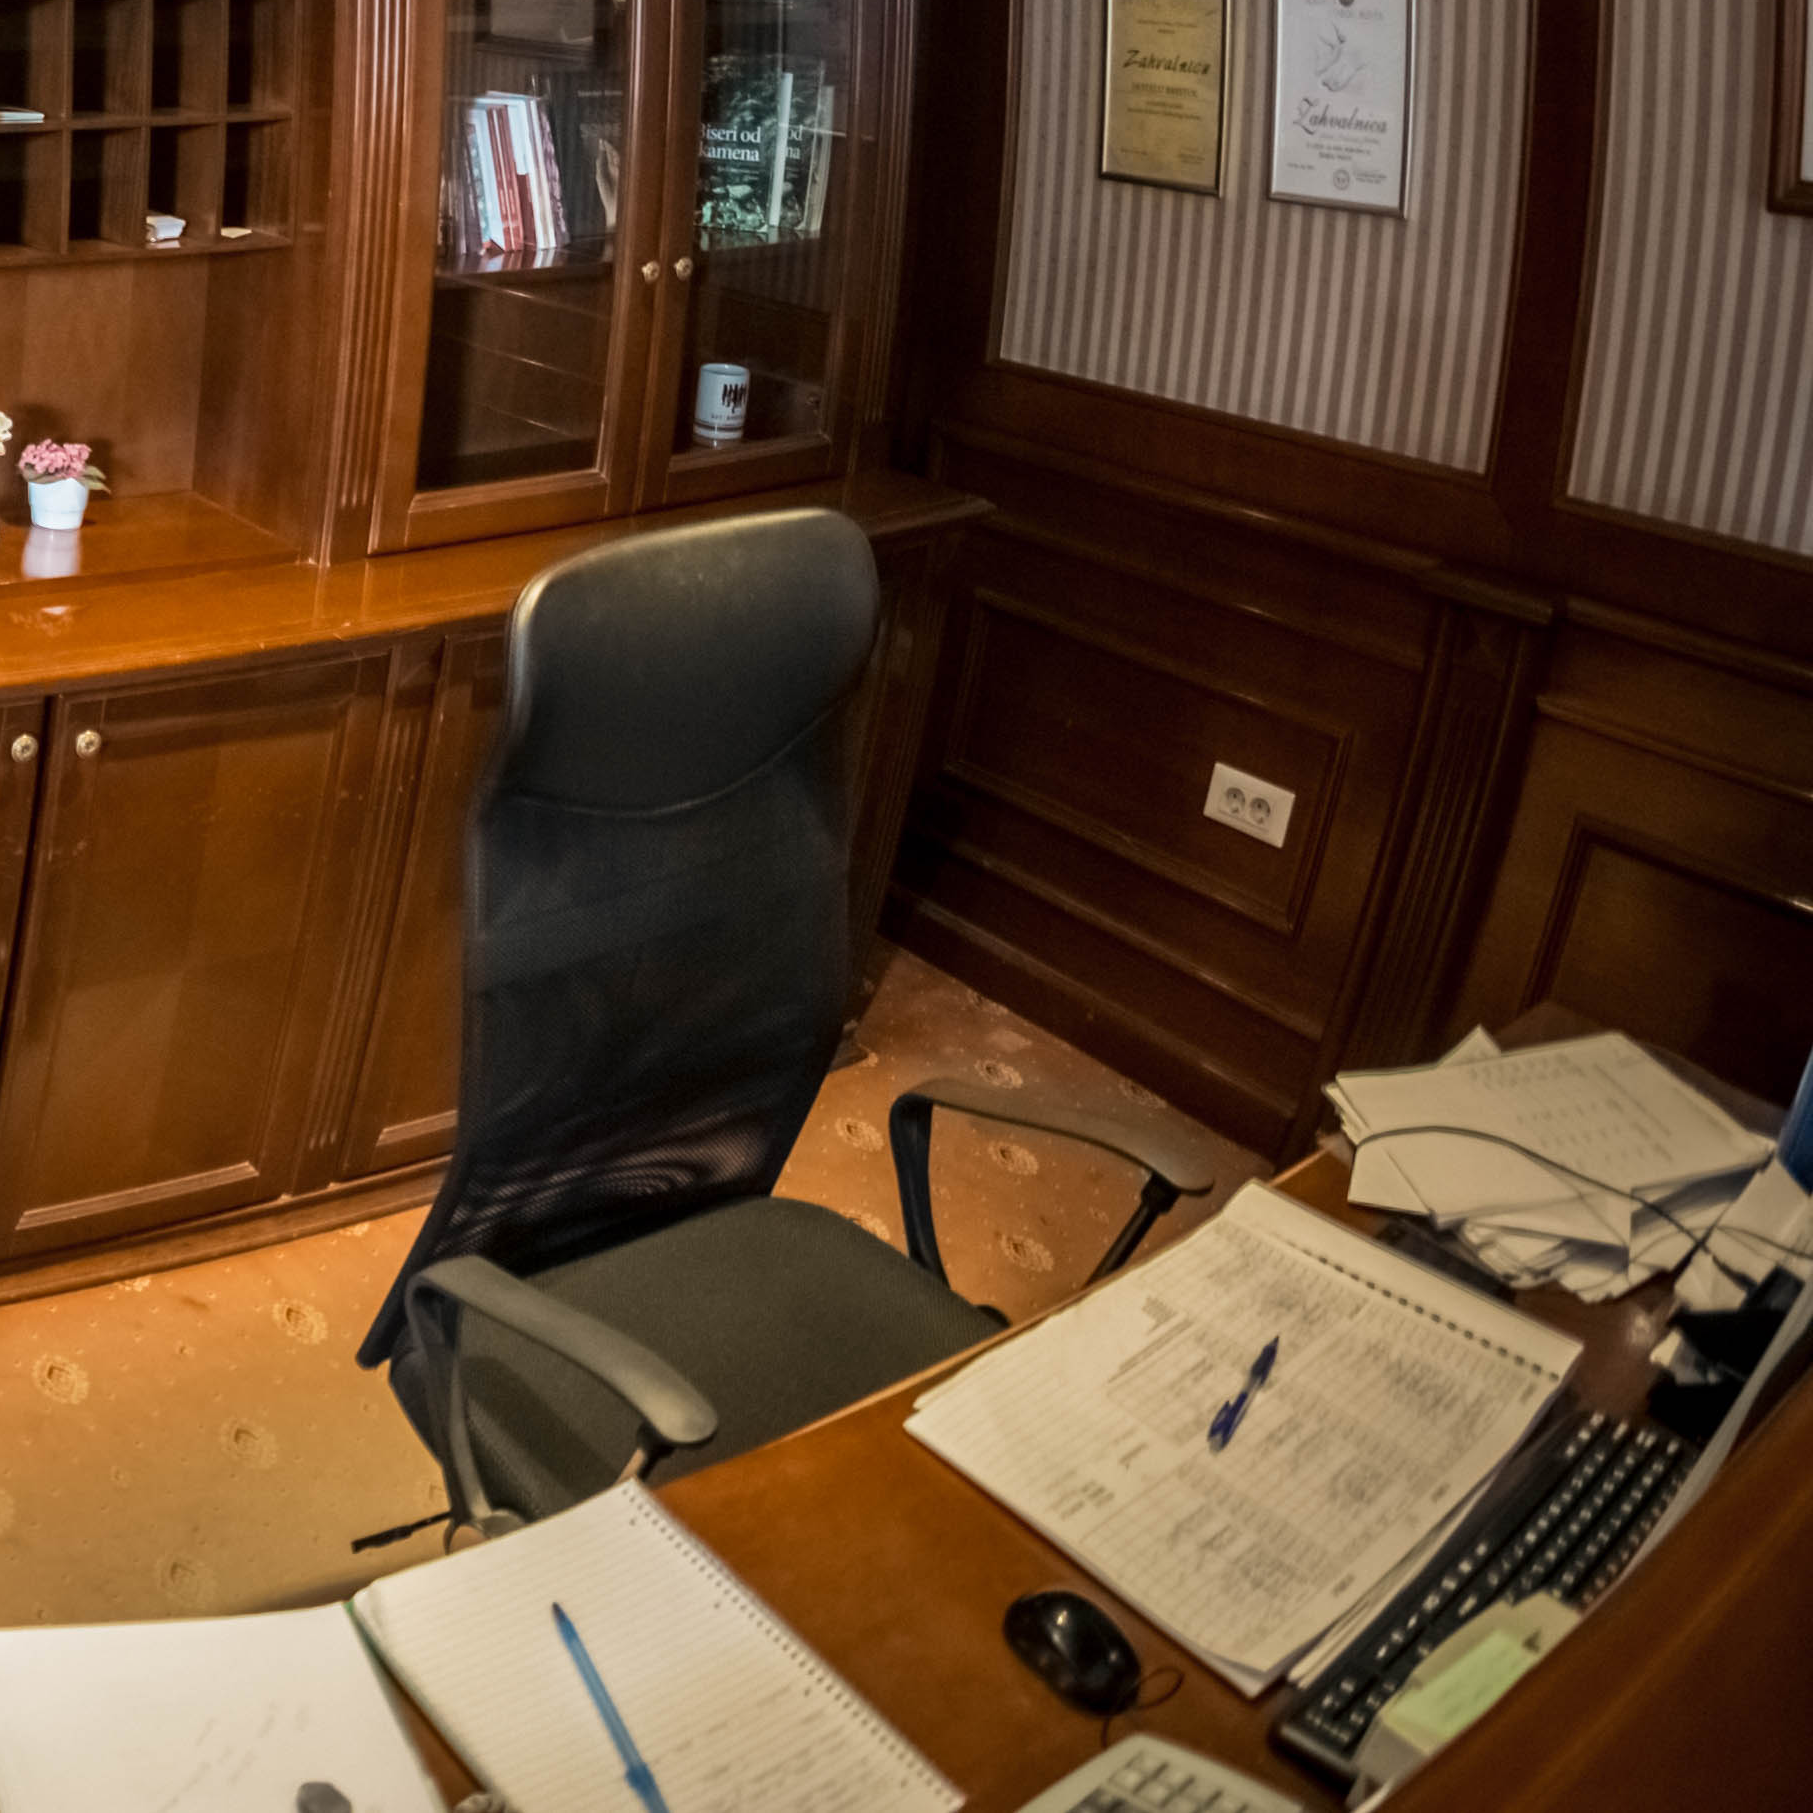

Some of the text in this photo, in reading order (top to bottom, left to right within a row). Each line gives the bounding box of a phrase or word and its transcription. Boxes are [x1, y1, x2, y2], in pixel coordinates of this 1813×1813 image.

[1122, 48, 1212, 76] Zahvalnica
[1292, 97, 1389, 136] Zahvalnica
[740, 125, 762, 143] od
[698, 140, 761, 162] kamena
